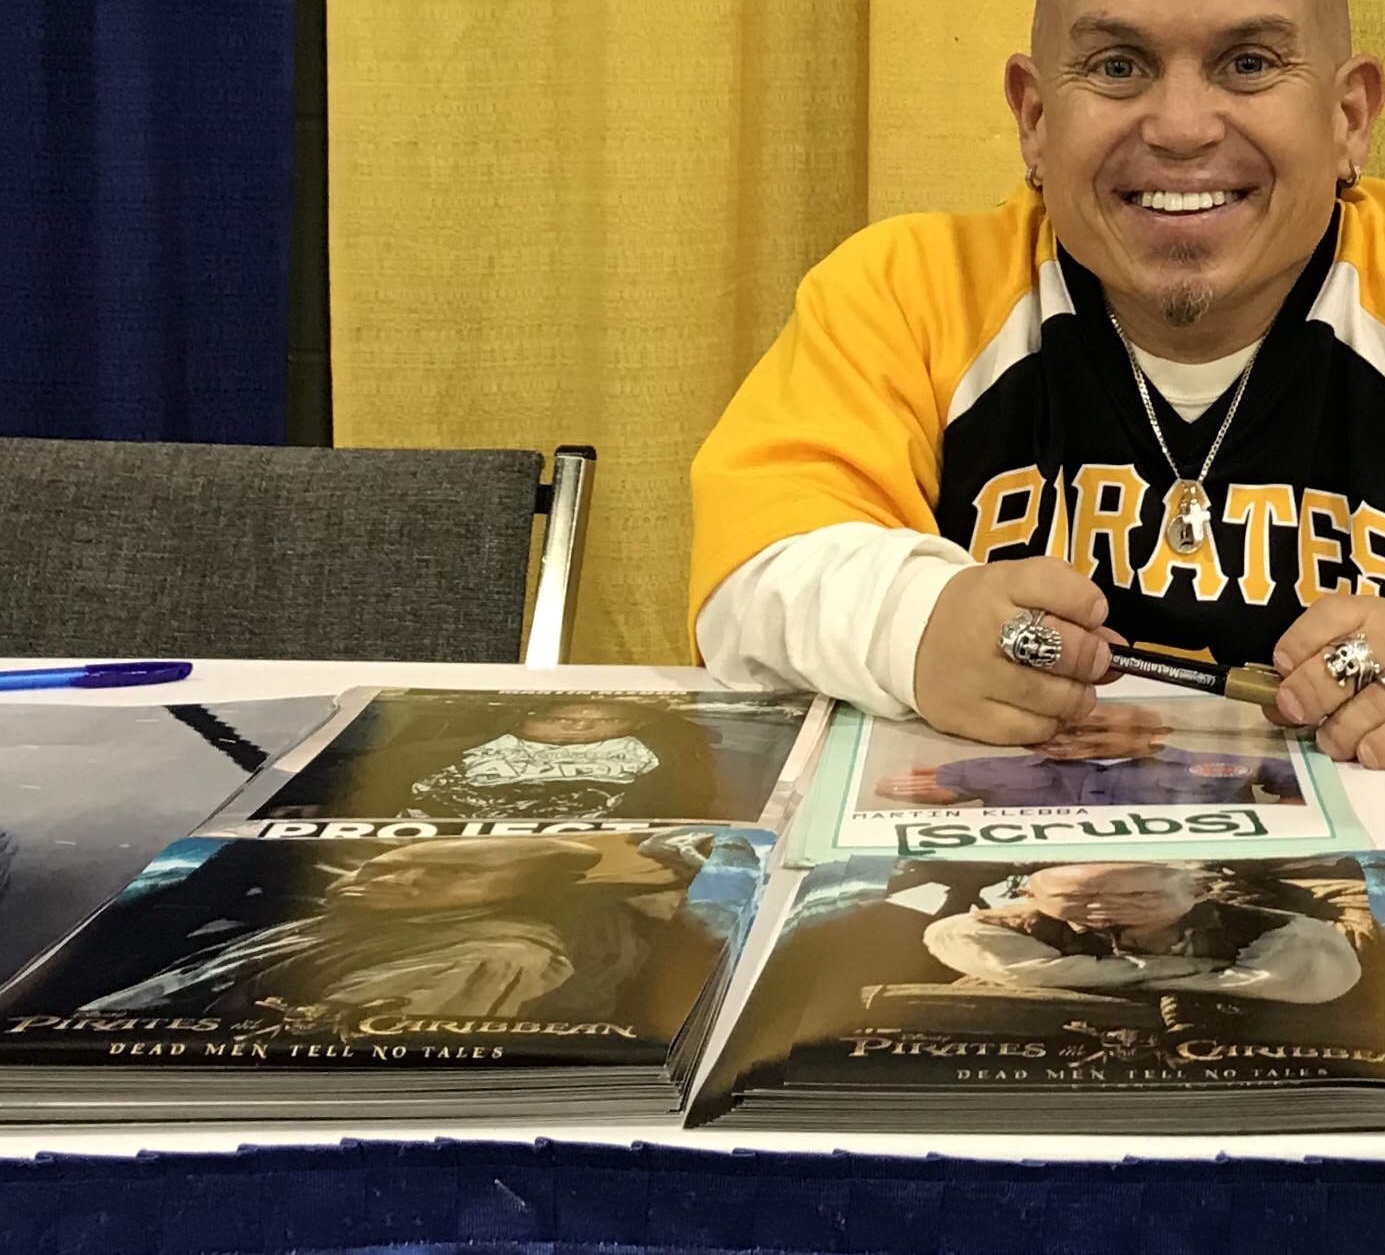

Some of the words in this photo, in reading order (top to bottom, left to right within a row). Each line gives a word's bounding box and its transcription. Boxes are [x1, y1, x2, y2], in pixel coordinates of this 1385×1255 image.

[852, 810, 961, 820] MARTIN
[982, 807, 1089, 817] KLEBBA
[3, 1014, 223, 1034] PIRATES
[358, 1013, 638, 1039] CARIBBEAN
[108, 1042, 186, 1056] DEAD
[204, 1041, 269, 1059] MEN
[290, 1043, 355, 1058] TELL
[371, 1044, 408, 1061] NO
[421, 1045, 505, 1059] TALES
[839, 1036, 1047, 1058] PIRATES
[957, 1068, 1029, 1080] DEAD
[1046, 1068, 1106, 1081] MEN
[1127, 1068, 1187, 1080] TELL
[1205, 1068, 1238, 1081] NO
[1253, 1067, 1329, 1078] TALES
